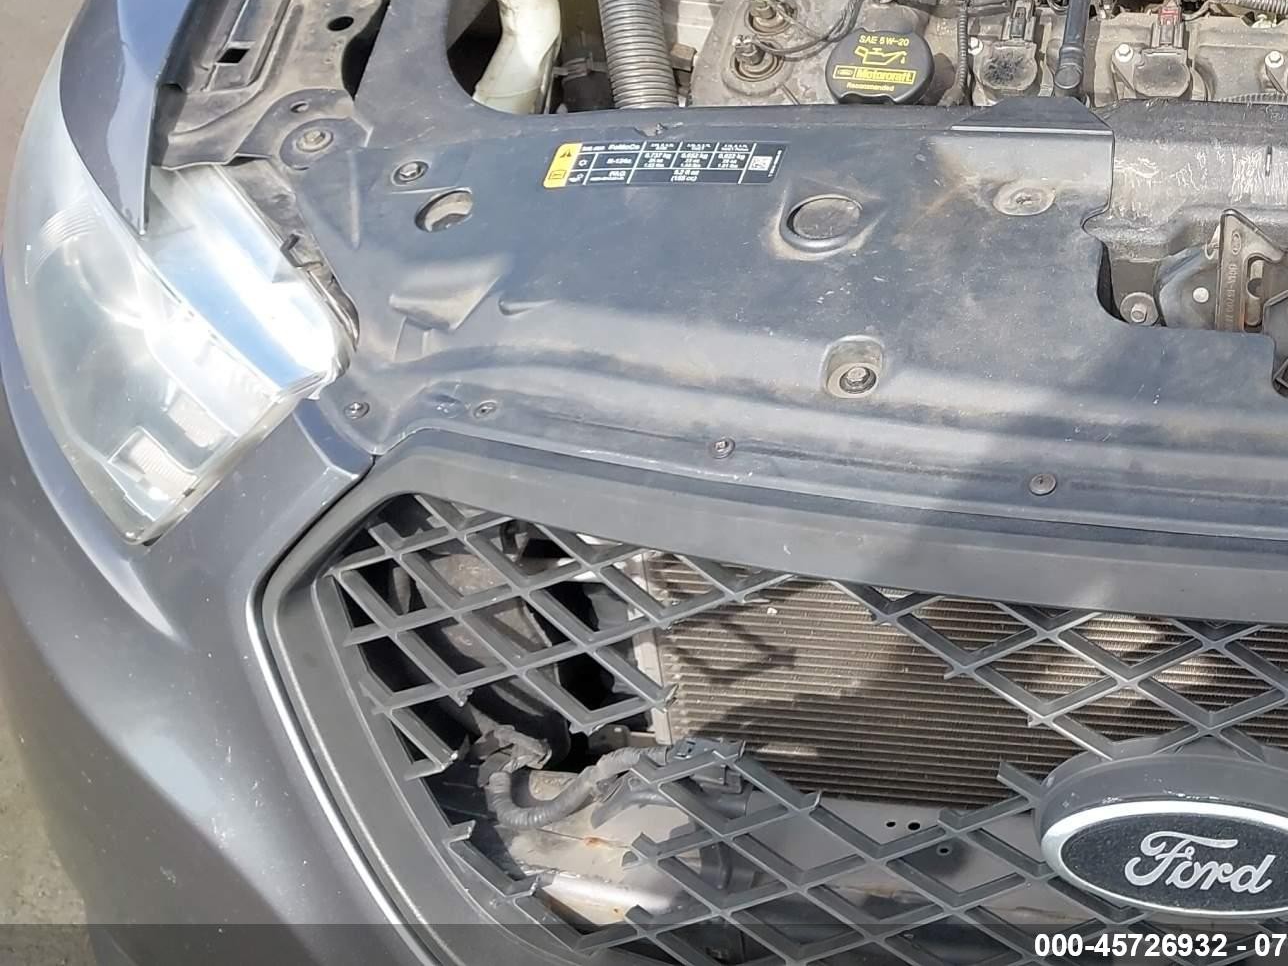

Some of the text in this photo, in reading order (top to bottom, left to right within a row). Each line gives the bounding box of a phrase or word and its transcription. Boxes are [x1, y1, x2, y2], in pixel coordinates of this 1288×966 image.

[858, 35, 910, 47] SAE 5W-20
[846, 82, 895, 92] Recommended
[1124, 830, 1276, 894] Ford
